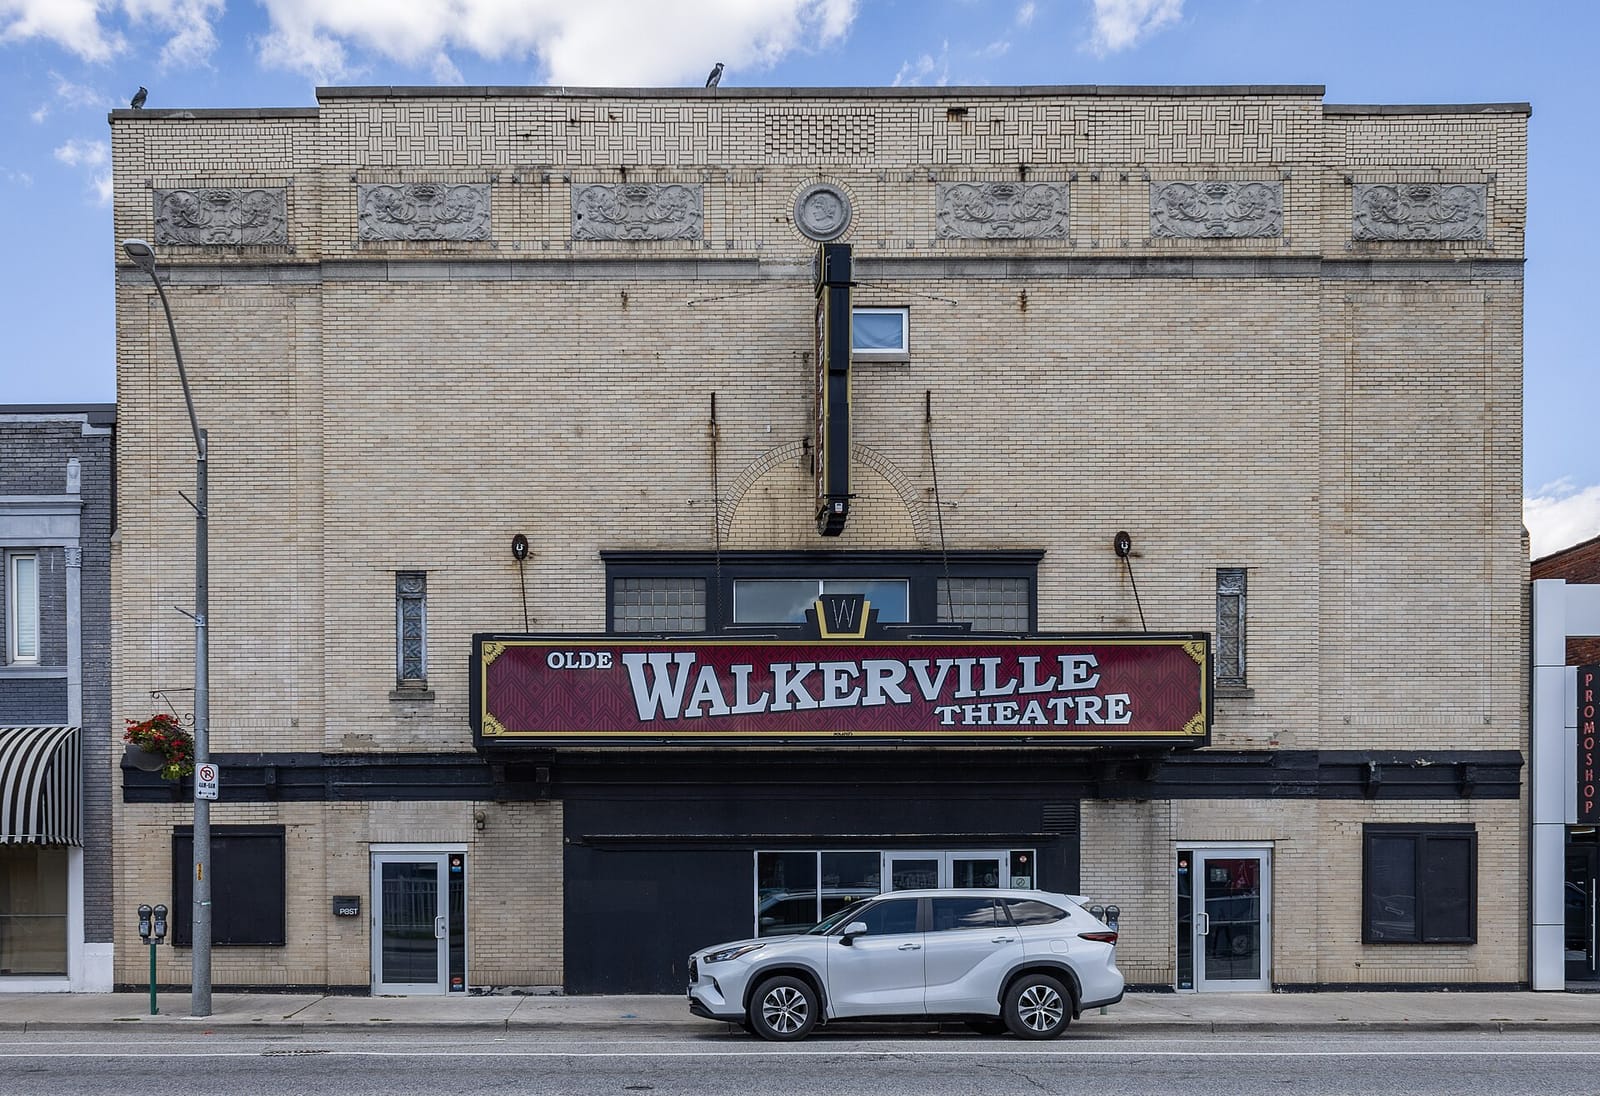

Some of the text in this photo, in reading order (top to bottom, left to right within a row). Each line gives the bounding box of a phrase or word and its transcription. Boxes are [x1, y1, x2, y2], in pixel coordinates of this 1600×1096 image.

[831, 599, 857, 628] W
[546, 651, 1101, 721] OLDE WALKERVILLE
[933, 693, 1133, 726] THEATRE
[1584, 673, 1595, 813] PROMOSHOP
